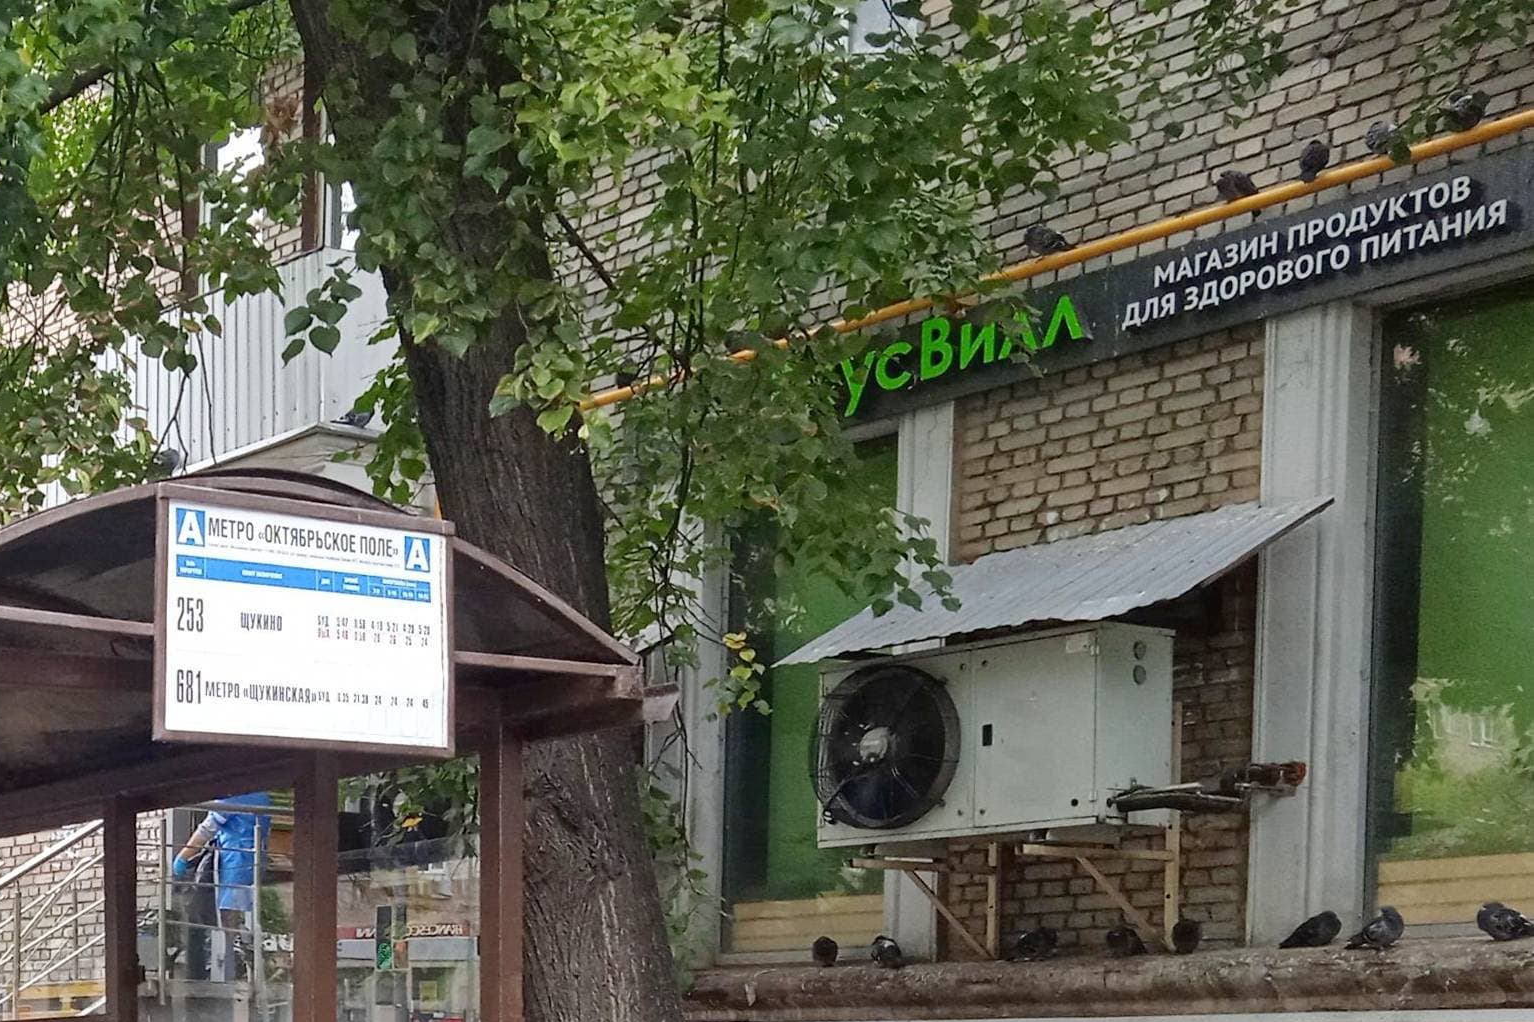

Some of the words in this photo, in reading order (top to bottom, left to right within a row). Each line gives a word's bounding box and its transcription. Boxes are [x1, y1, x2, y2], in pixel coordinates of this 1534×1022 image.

[1153, 230, 1279, 288] МАГАЗИН
[1286, 175, 1472, 251] ПРОДУКТОВ
[1121, 293, 1176, 330] ДЛЯ
[1183, 244, 1350, 311] ЗДОРОВОГО
[1359, 199, 1508, 263] ПИТАНИЯ
[208, 517, 254, 541] МЕТРО
[258, 524, 356, 554] «ОКТЯБРЬСКОЕ
[359, 536, 399, 558] ПОЛЕ»
[177, 596, 204, 632] 253
[240, 612, 283, 631] ЩУКИНО
[177, 669, 202, 704] 681
[205, 681, 240, 698] МЕТРО
